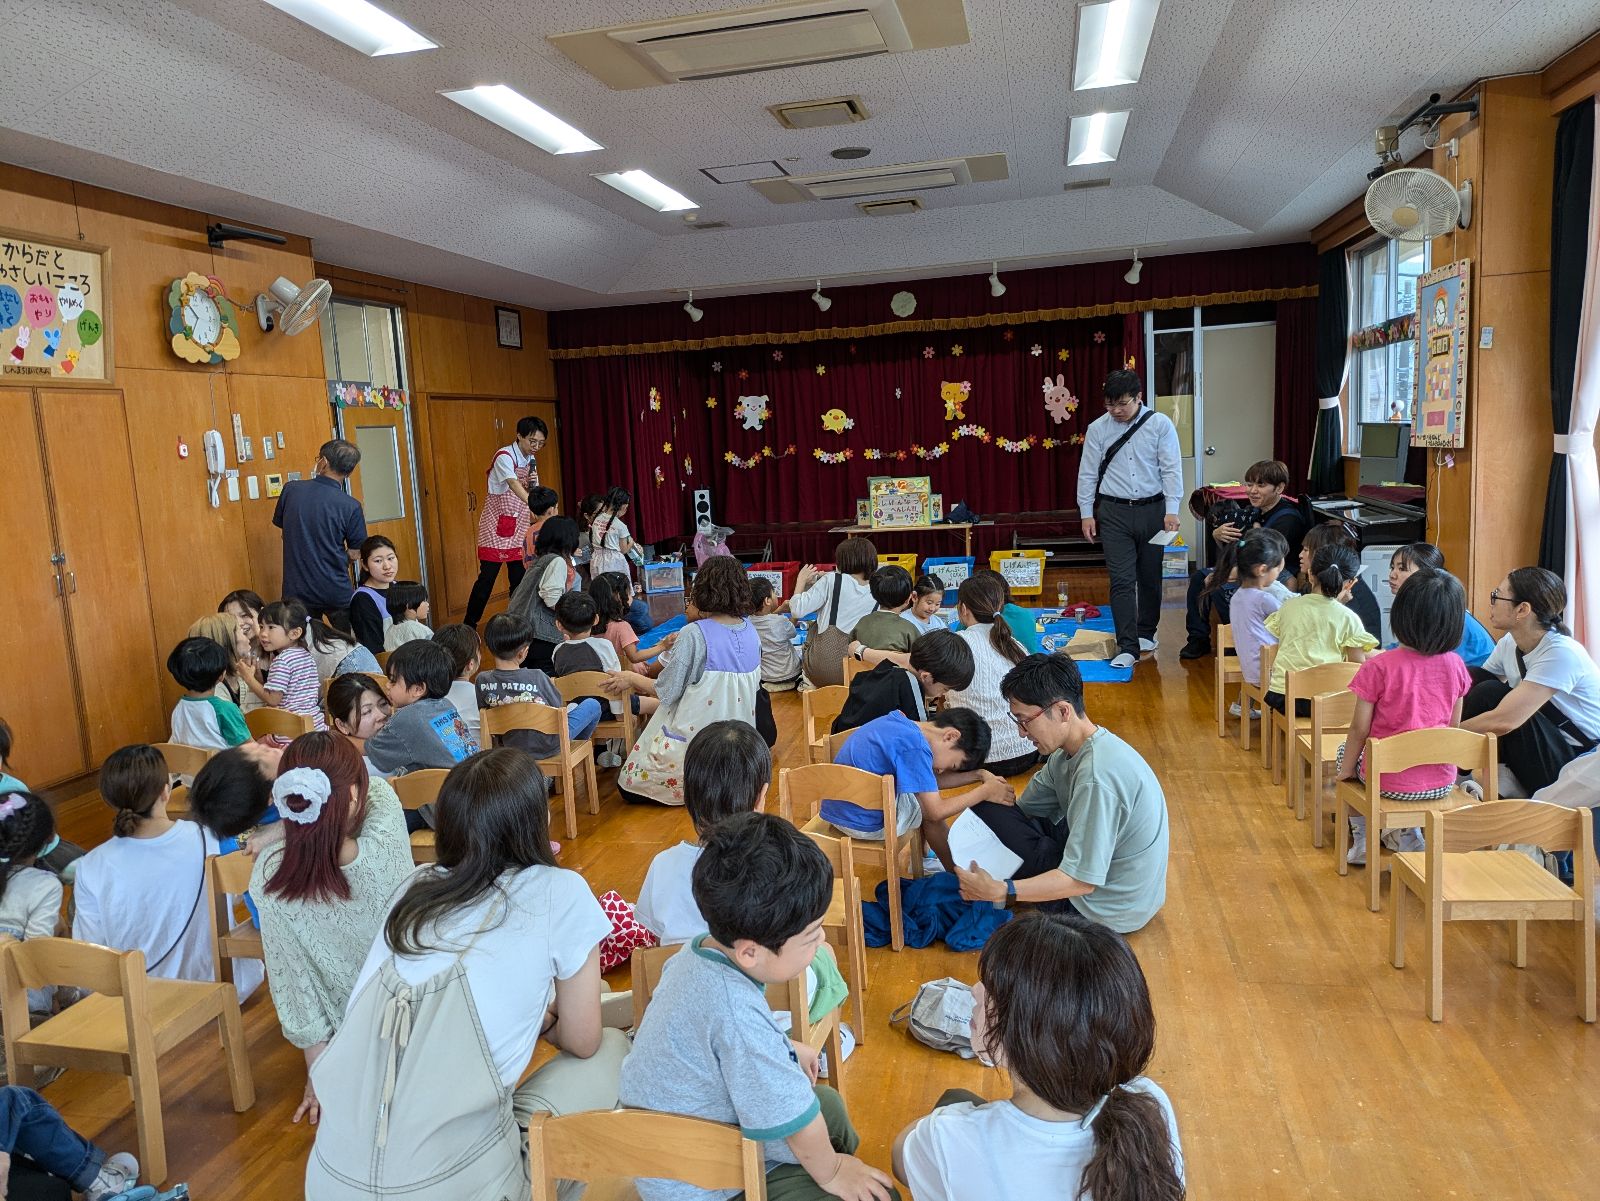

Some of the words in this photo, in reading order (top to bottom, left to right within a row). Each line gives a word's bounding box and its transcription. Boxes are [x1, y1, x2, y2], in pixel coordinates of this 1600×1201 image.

[2, 242, 65, 270] からだと
[34, 308, 52, 321] やり
[79, 318, 99, 335] げんき
[1003, 561, 1039, 569] しげんぶつ
[480, 682, 498, 692] PAW
[501, 682, 539, 693] PATROL
[433, 717, 449, 729] THIS
